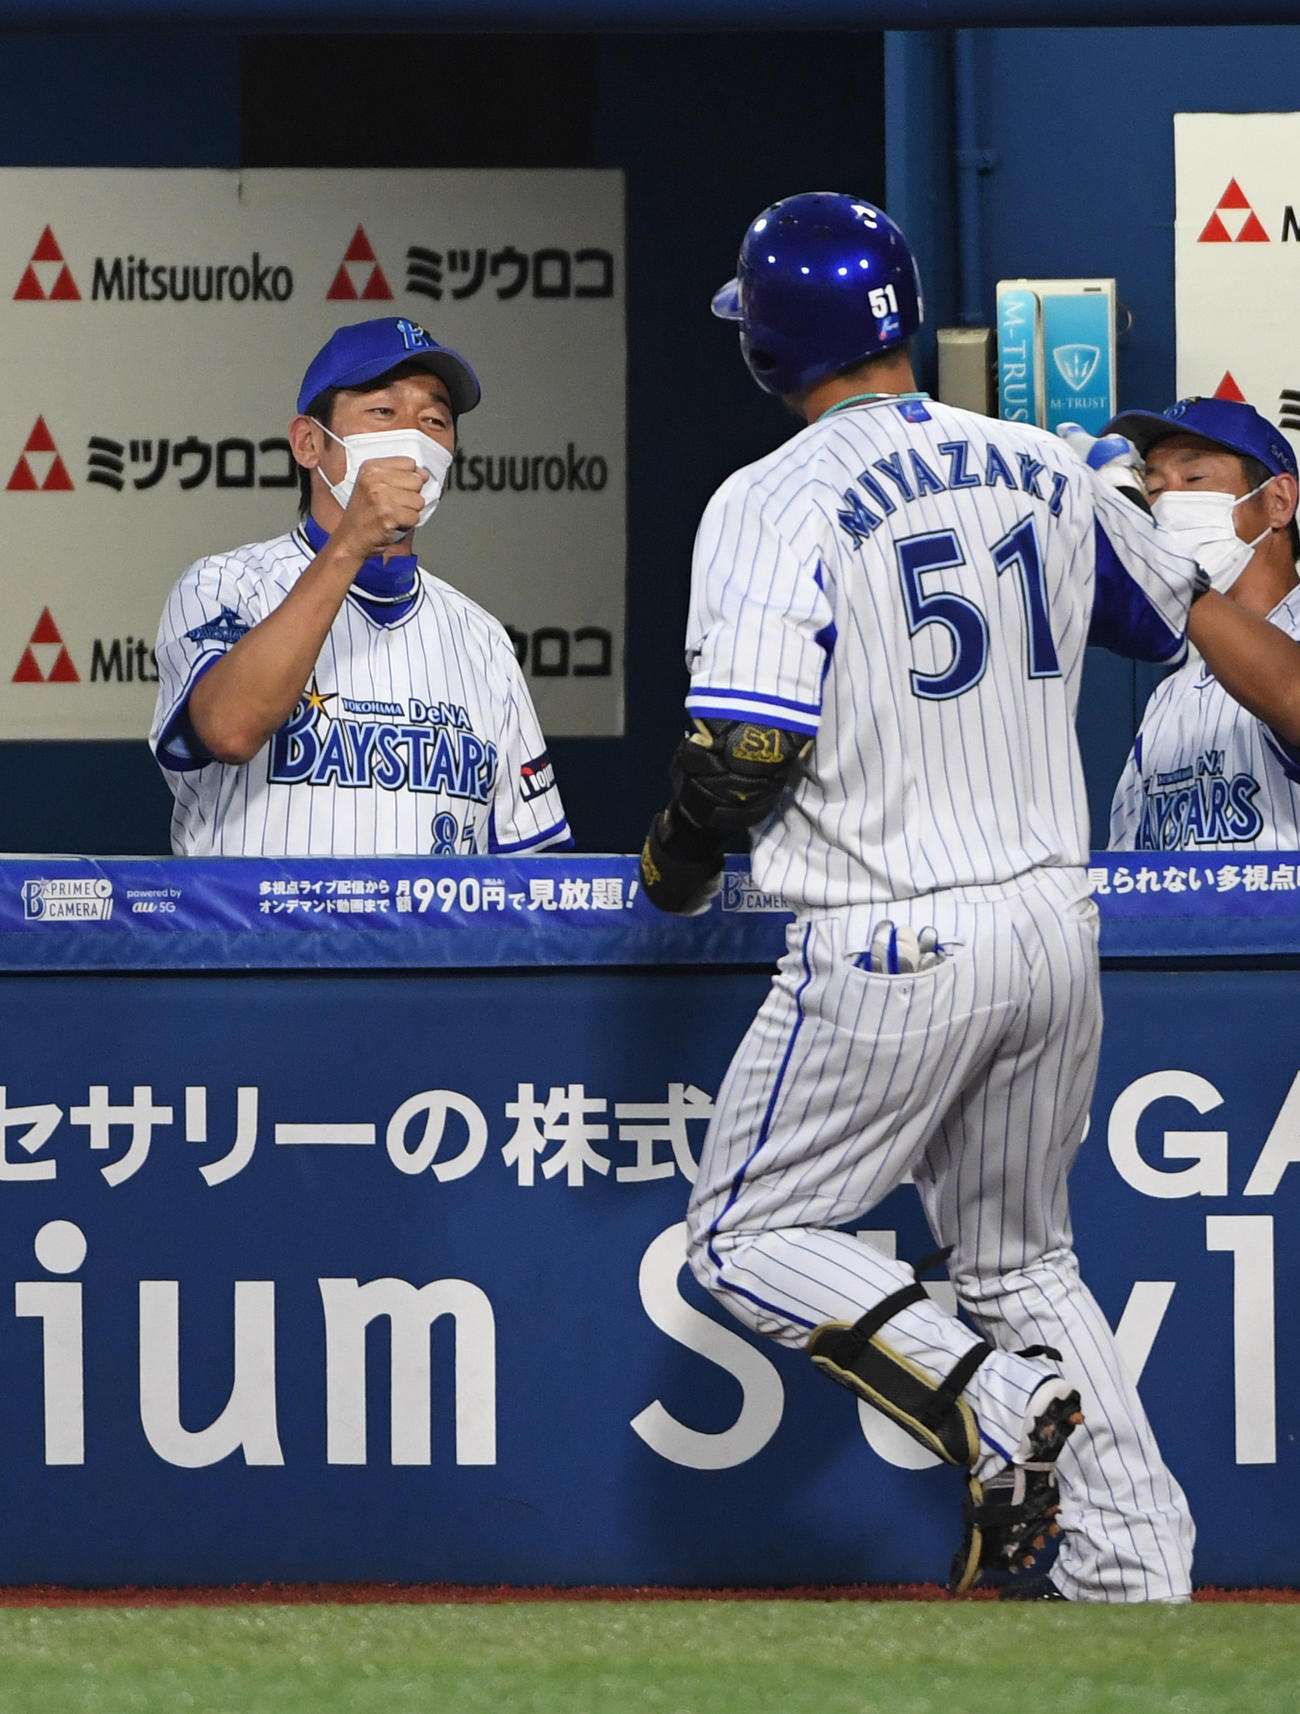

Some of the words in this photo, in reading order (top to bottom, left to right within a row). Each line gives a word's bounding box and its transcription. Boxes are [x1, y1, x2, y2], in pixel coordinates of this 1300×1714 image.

[91, 251, 294, 302] Mitsuuroko
[405, 245, 614, 301] ミツウロコ
[868, 284, 899, 318] 51
[1003, 301, 1028, 421] M-TRUS
[1050, 397, 1107, 409] M-TRUST
[87, 435, 298, 492] ミツウロコ
[448, 441, 608, 492] tsuuroko
[836, 440, 1068, 551] MIYAZAKI
[893, 512, 1062, 701] 51
[342, 697, 404, 716] YOKOHAMA
[408, 698, 473, 731] DeNA
[267, 699, 498, 804] BAYSTARS
[51, 882, 91, 895] PRIME
[127, 889, 168, 899] powered
[169, 889, 182, 899] by
[1087, 863, 1300, 893] 見られない多視点
[49, 902, 99, 917] CAMERA
[132, 902, 157, 913] au
[746, 895, 789, 909] CAMER
[15, 1219, 498, 1468] ium
